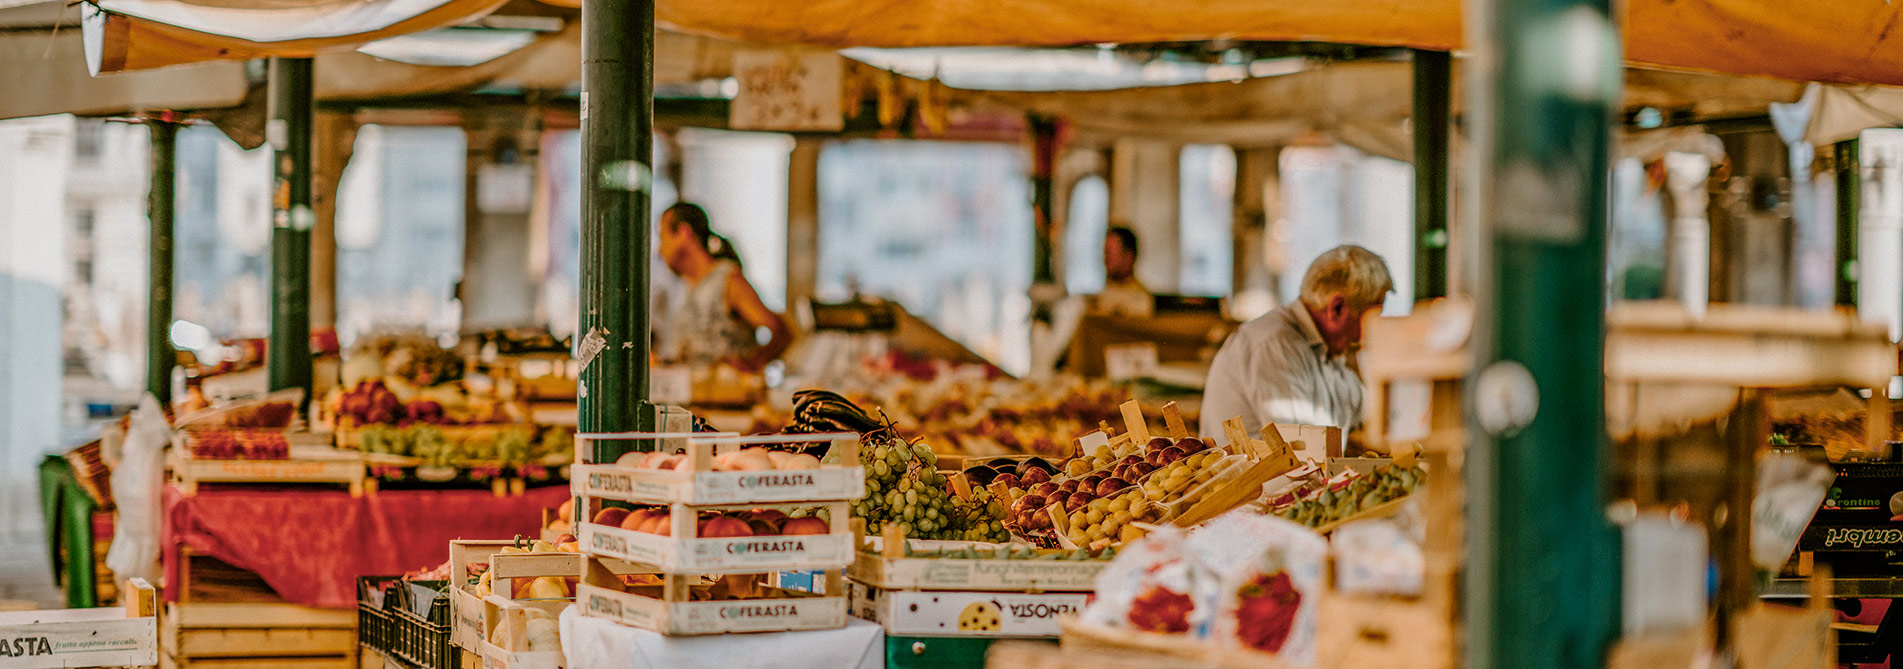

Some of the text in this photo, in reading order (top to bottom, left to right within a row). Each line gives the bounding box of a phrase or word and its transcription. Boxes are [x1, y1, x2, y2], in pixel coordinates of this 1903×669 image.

[738, 474, 814, 489] COFERASTA
[1825, 528, 1903, 548] embri
[726, 541, 805, 554] COFERASTA
[720, 605, 798, 619] COFERASTA
[1009, 603, 1080, 619] VENOSTA
[0, 636, 53, 657] ASTA
